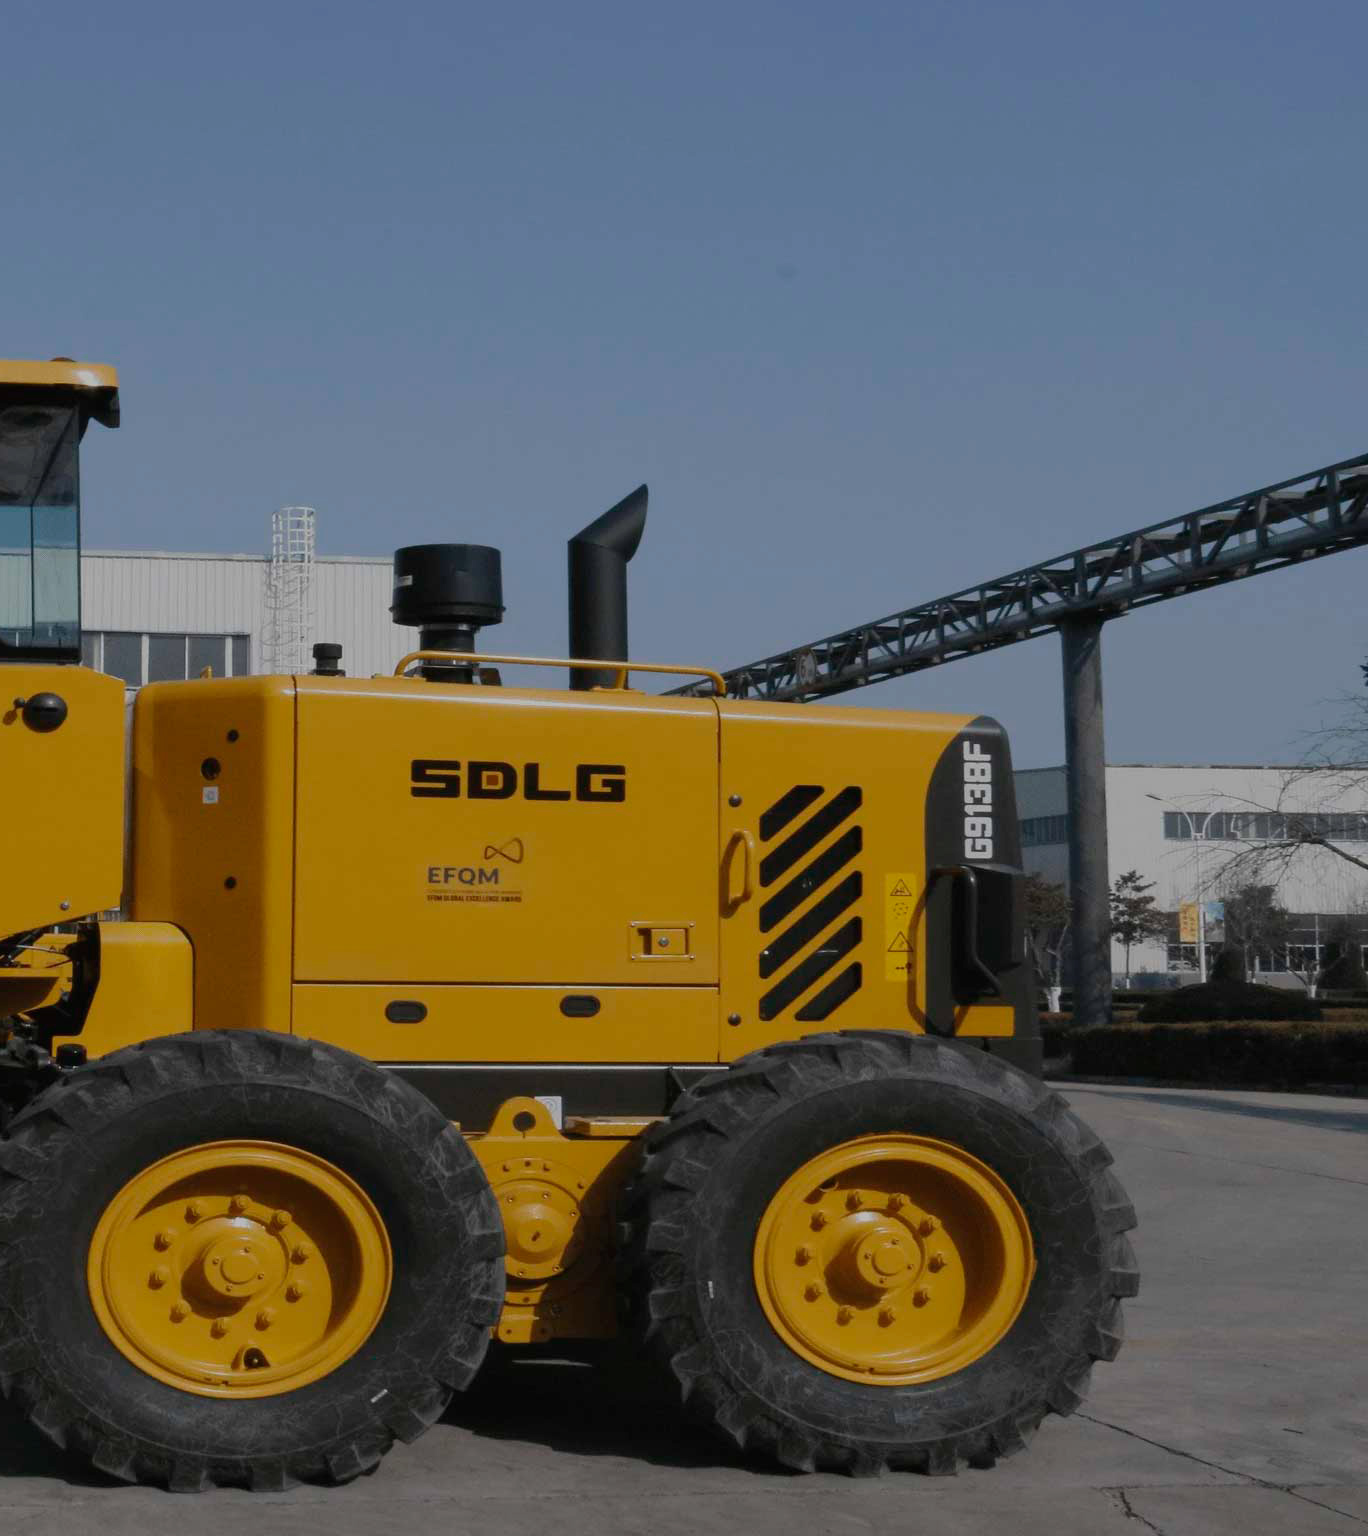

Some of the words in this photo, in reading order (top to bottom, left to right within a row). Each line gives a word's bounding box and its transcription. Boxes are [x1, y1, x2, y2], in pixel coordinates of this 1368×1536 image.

[410, 759, 626, 802] SDLG
[963, 741, 993, 859] G9138F
[428, 867, 499, 885] EFQM
